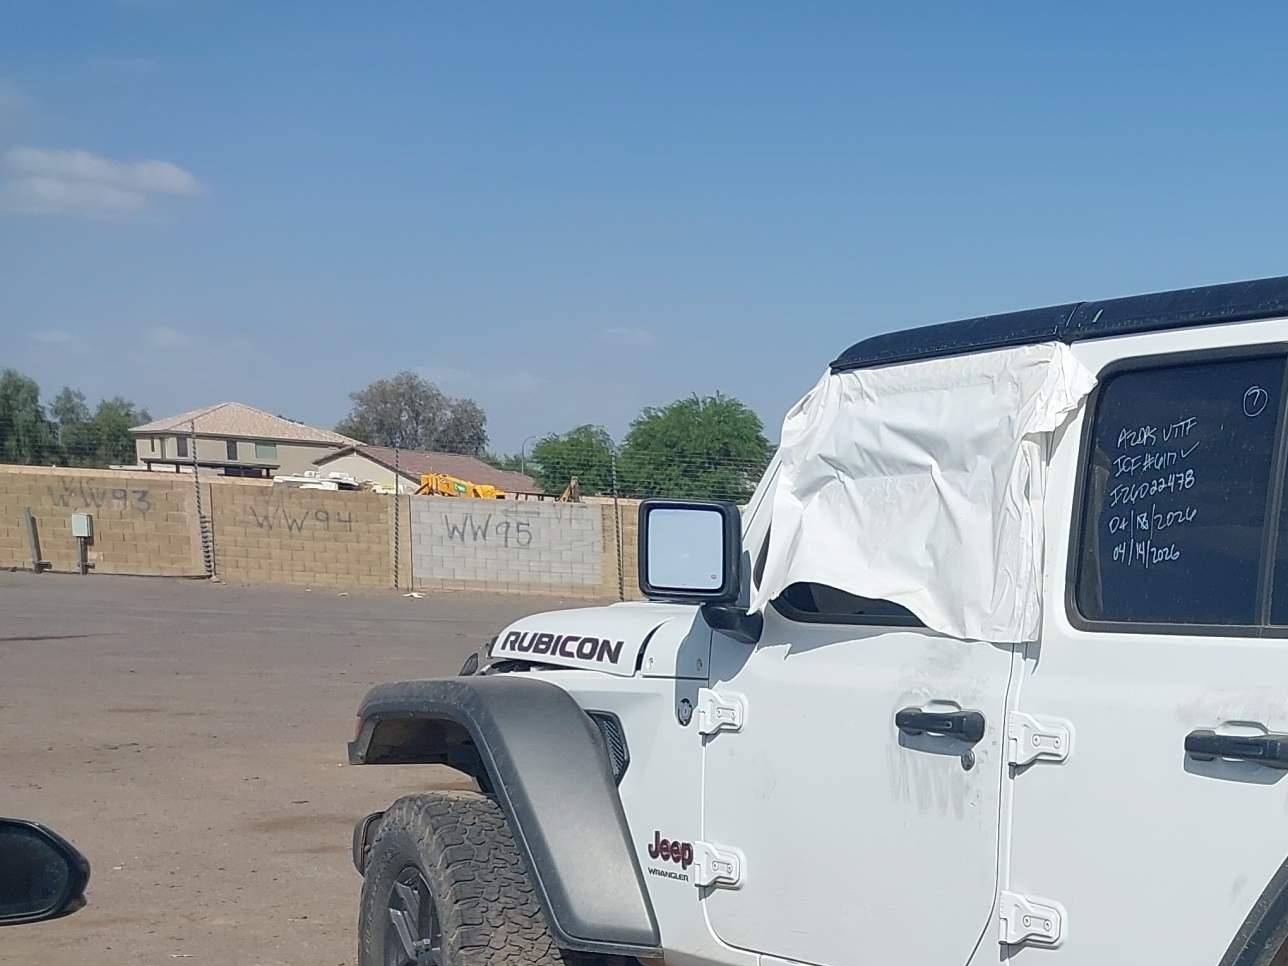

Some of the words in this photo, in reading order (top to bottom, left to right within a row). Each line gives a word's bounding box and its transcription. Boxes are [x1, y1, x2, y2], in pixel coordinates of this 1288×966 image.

[48, 485, 151, 513] WW93
[249, 506, 353, 533] WW94
[444, 513, 533, 549] WW95
[1113, 538, 1180, 569] 04/14/2026
[501, 630, 625, 665] RUBICON
[647, 830, 695, 871] Jeep
[647, 866, 690, 882] WRANGLER
